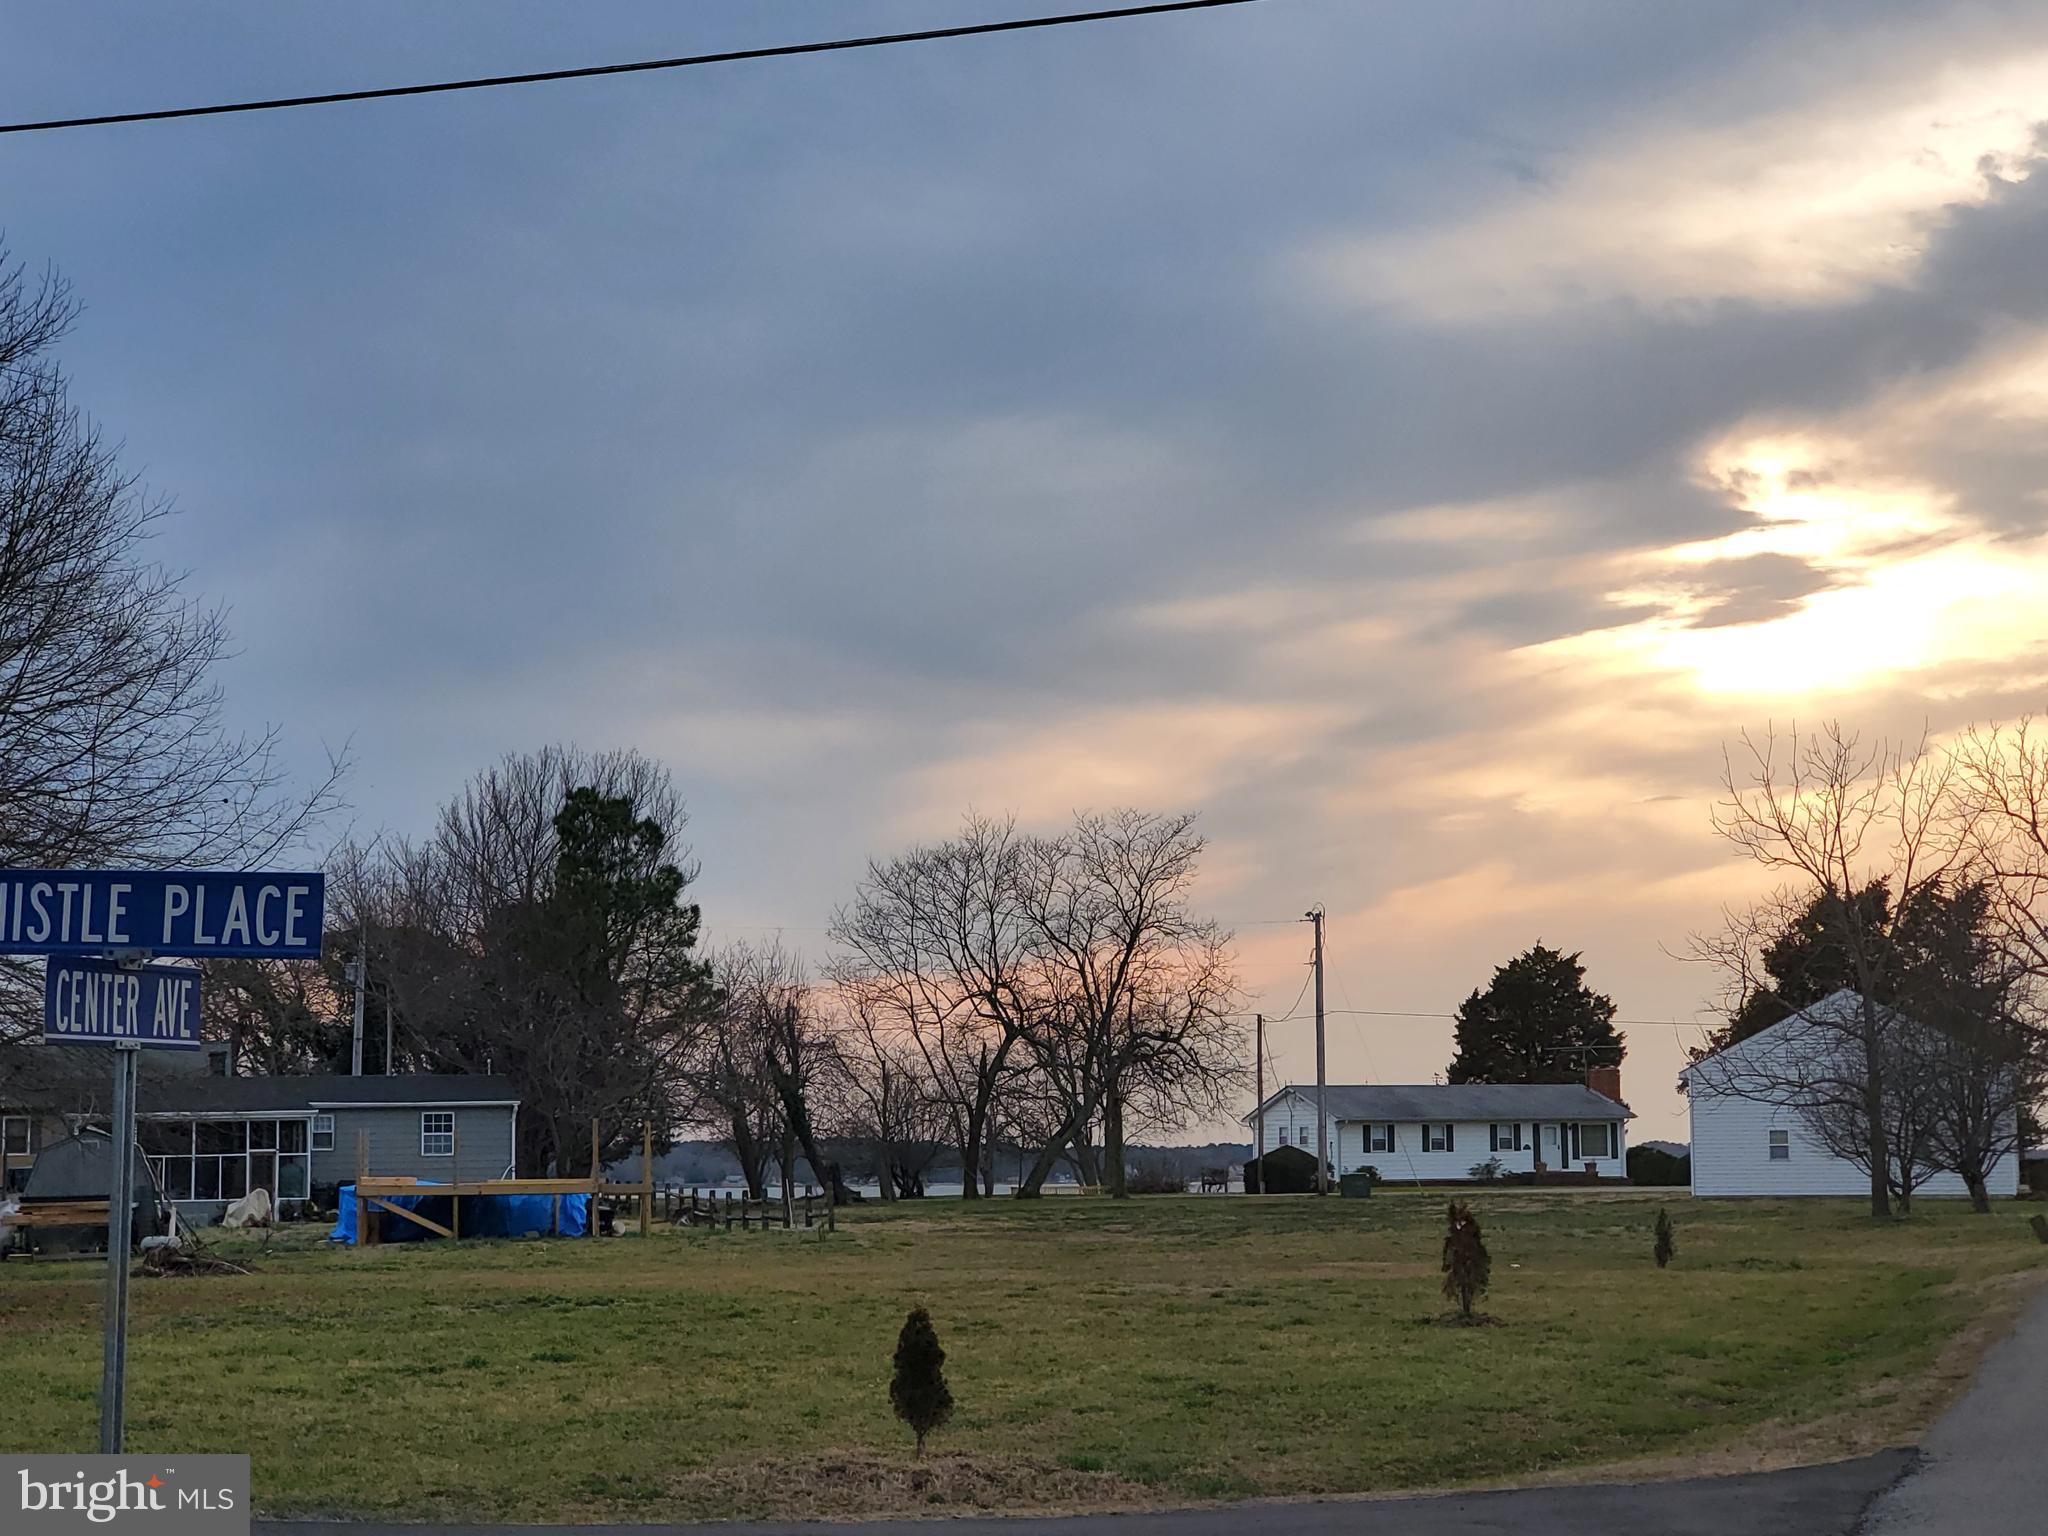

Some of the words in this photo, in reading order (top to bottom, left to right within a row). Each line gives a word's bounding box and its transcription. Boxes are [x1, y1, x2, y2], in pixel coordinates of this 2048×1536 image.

[0, 882, 132, 943] ISTLE
[162, 884, 310, 946] PLACE
[55, 968, 140, 1036] CENTER
[152, 977, 193, 1038] AVE
